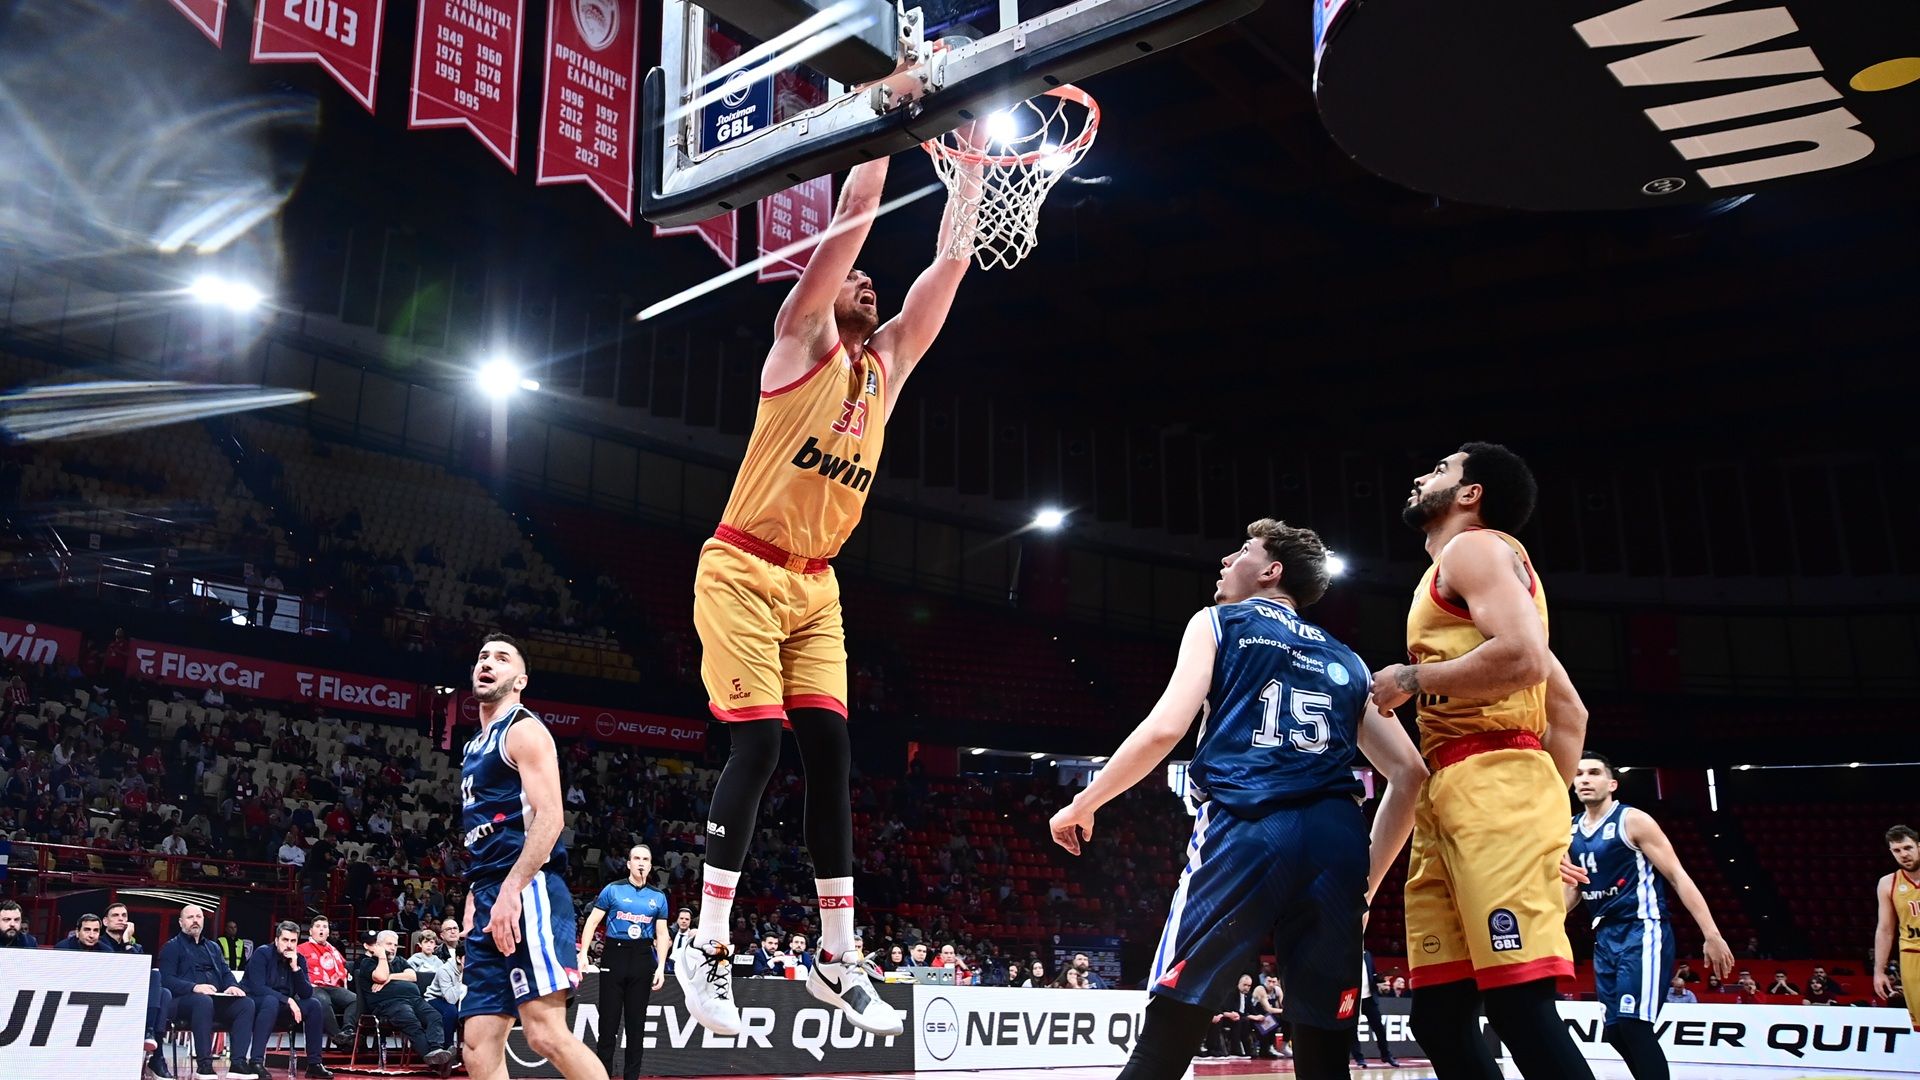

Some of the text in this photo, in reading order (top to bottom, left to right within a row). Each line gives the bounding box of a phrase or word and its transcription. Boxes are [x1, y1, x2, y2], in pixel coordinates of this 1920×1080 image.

[283, 0, 359, 47] 2013
[444, 2, 499, 41] ΕΛΛΑΔΑΣ
[435, 42, 502, 85] 1976 1978
[437, 24, 503, 67] 1949 1960
[434, 60, 500, 103] 1993 1994
[555, 43, 628, 92] ΠΡΩΤΑΘΛΗΤΗΣ
[566, 64, 616, 101] ΕΛΛΑΔΑΣ
[453, 87, 480, 112] 1995
[560, 86, 619, 126] 1996 1997
[715, 104, 757, 128] Stoiximan
[558, 120, 618, 160] 2016 2022
[560, 103, 618, 143] 2012 2015
[716, 115, 754, 143] GBL
[575, 145, 600, 169] 2023
[830, 398, 867, 440] 33
[790, 435, 873, 493] bwin
[161, 652, 265, 690] FlexCar
[1291, 650, 1324, 669] κόσμος
[1291, 660, 1325, 675] seafood
[319, 674, 412, 711] FlexCar
[729, 691, 751, 701] FlexCar
[543, 712, 581, 726] QUIT
[617, 721, 667, 736] NEVER
[670, 727, 704, 740] QUIT
[1251, 678, 1332, 755] 15
[1578, 851, 1599, 874] 14
[1493, 938, 1520, 950] GBL
[925, 1021, 957, 1034] GSA
[965, 1011, 1096, 1047] NEVER
[1766, 1023, 1912, 1060] QUIT
